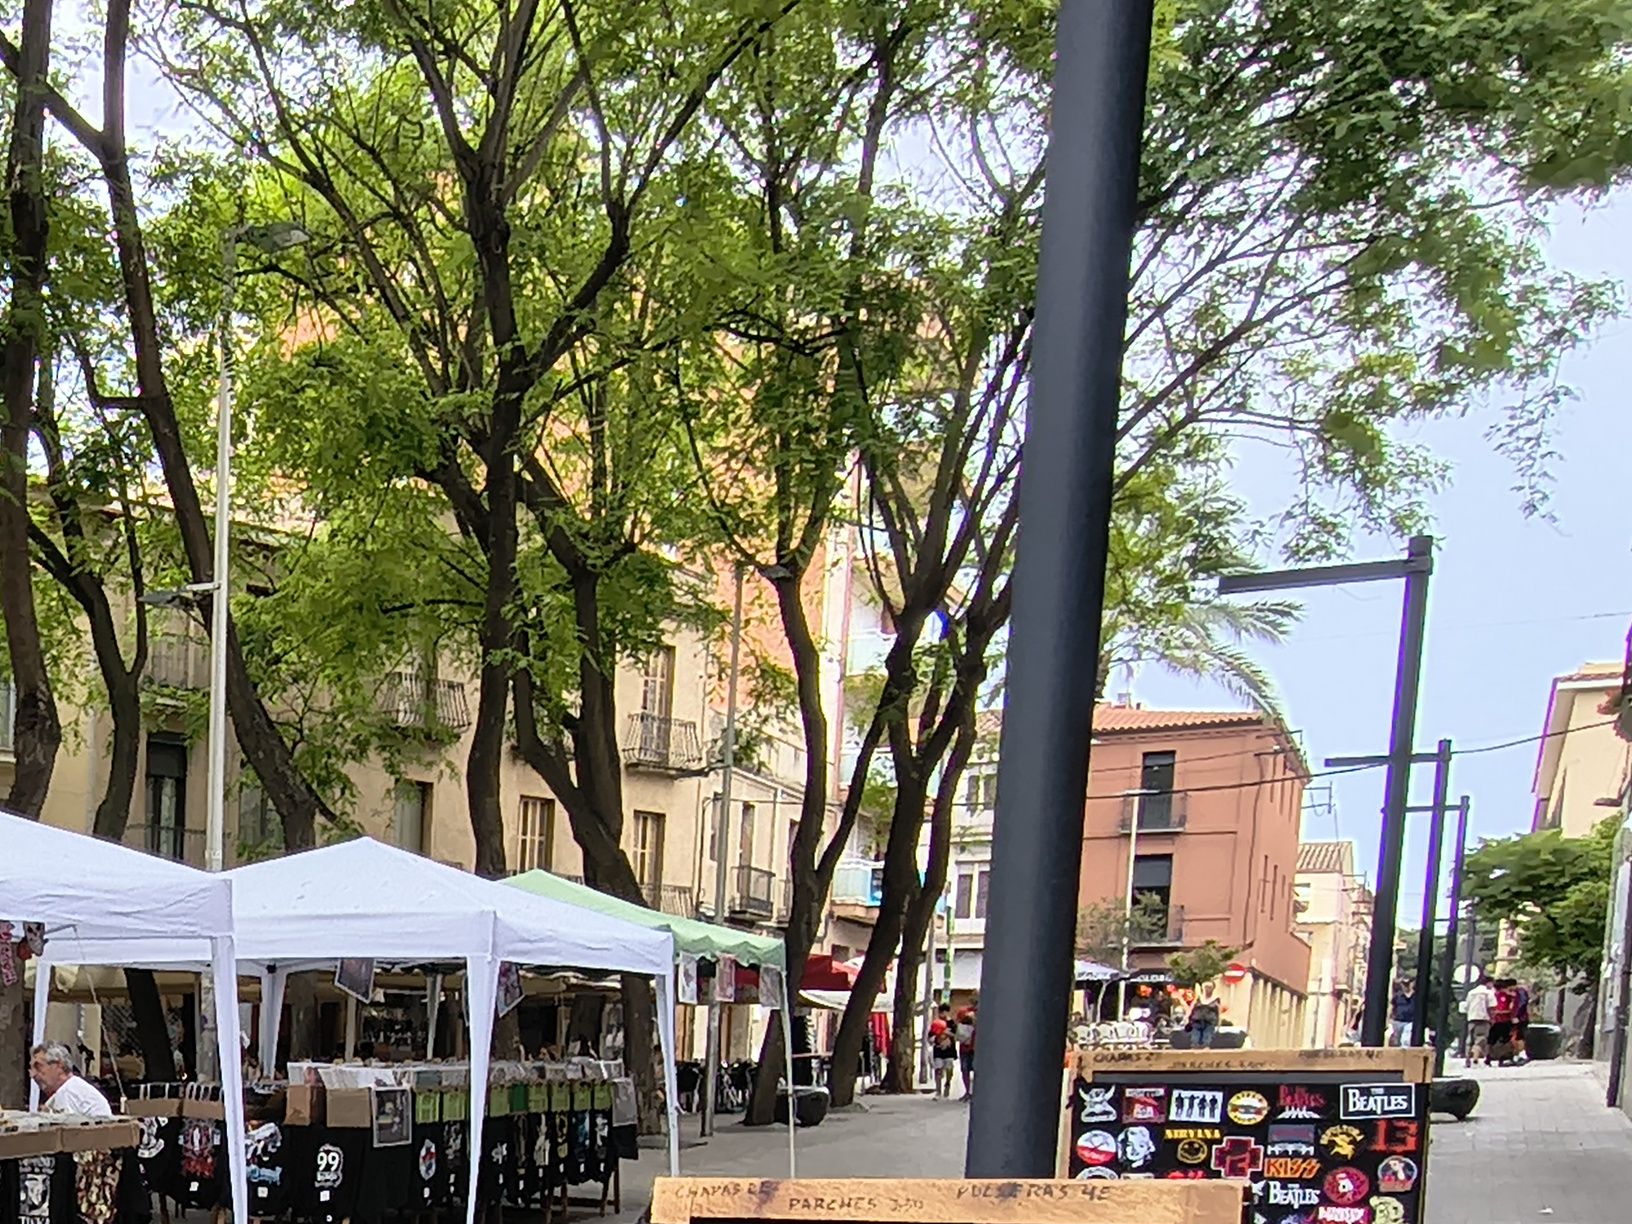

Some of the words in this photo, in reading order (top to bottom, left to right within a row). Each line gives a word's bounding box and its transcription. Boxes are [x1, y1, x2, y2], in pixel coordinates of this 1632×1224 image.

[1348, 1088, 1409, 1115] BEATLES
[1164, 1128, 1221, 1139] NIRVANA
[1372, 1119, 1419, 1153] 13
[1263, 1157, 1322, 1180] KISS
[788, 1198, 878, 1212] PARCHES
[1269, 1180, 1321, 1209] BEATLES
